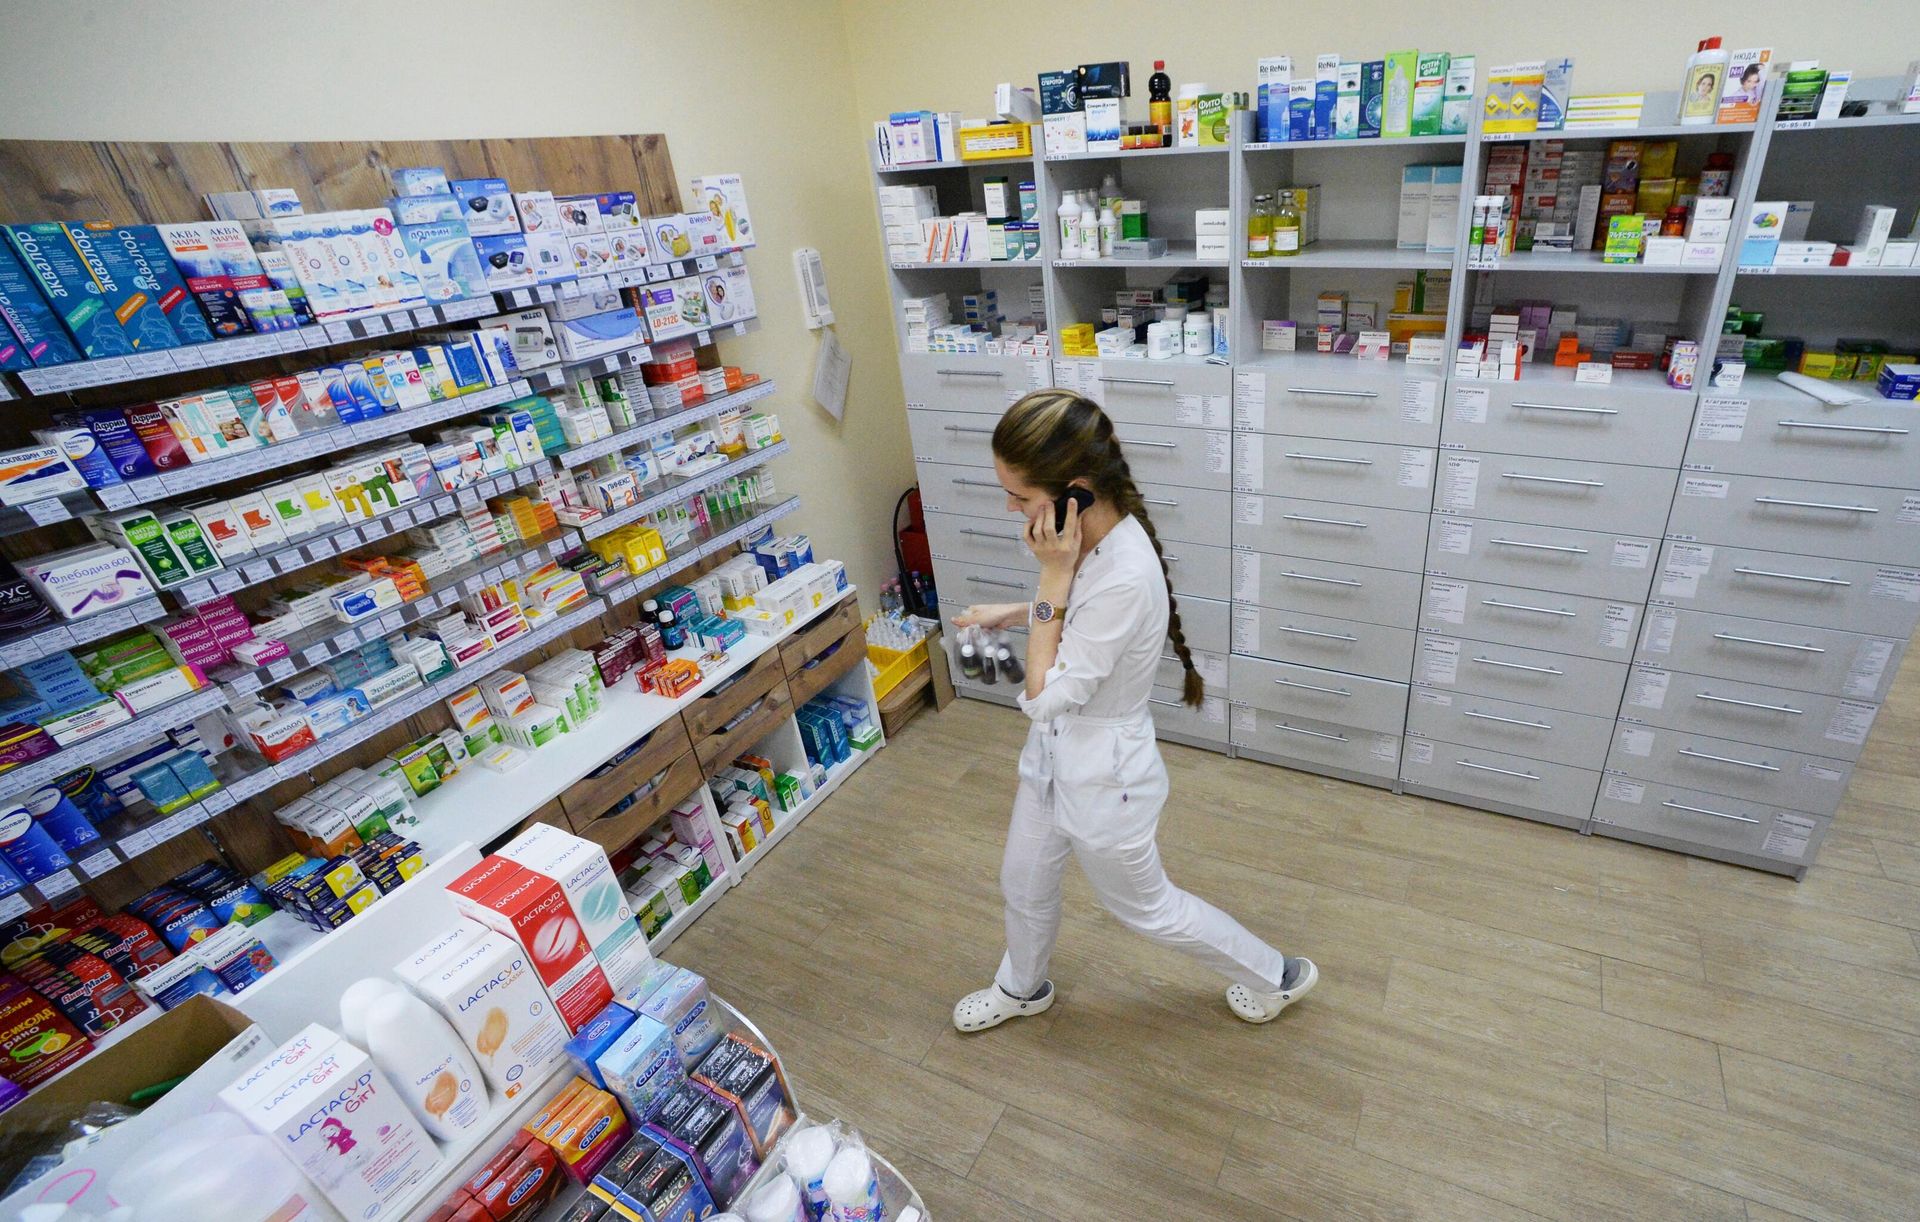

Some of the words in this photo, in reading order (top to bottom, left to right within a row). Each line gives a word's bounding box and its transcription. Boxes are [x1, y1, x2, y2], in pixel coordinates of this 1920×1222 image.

[1318, 62, 1336, 70] ReNu
[1734, 52, 1757, 60] НЮДА
[170, 230, 200, 239] АКВА
[210, 227, 239, 236] АКВА
[16, 232, 68, 297] аквалор
[71, 229, 118, 292] аквалор
[119, 230, 161, 291] аквалор
[95, 420, 126, 431] Африн
[132, 413, 162, 424] Африн
[607, 477, 630, 491] ЛИНЕКС
[50, 563, 111, 585] Флебодиа
[112, 555, 131, 568] 600
[597, 559, 622, 577] ТРИМЕДАТ
[165, 617, 200, 633] ИМУДОН
[203, 606, 235, 620] ИМУДОН
[213, 616, 245, 631] ИМУДОН
[176, 628, 209, 644] ИМУДОН
[219, 628, 250, 644] ИМУДОН
[182, 640, 216, 657] ИМУДОН
[255, 645, 286, 661] ИМУДОН
[370, 671, 416, 696] Эргоферон
[352, 802, 373, 820] Гербион
[323, 818, 345, 837] Гербион
[461, 860, 507, 892] LACTACYD
[566, 855, 605, 889] LACTACYD
[210, 883, 248, 907] COLDREX
[495, 876, 540, 909] LACTACYD
[166, 907, 205, 932] COLDREX
[518, 891, 561, 927] LACTACYD
[550, 901, 565, 915] EXTRA
[214, 936, 255, 966] Антигриппин
[153, 962, 199, 991] Антигриппин
[234, 982, 245, 991] 10
[459, 960, 522, 1011] LACTACYD
[501, 969, 525, 989] CLASSIC
[675, 1001, 706, 1035] durex
[236, 1036, 308, 1091] LACTACYD
[285, 1043, 312, 1066] Girl
[312, 1062, 340, 1085] Girl
[416, 1054, 452, 1086] LACTACYD
[636, 1050, 670, 1087] durex
[264, 1054, 336, 1111] LACTACYD
[288, 1069, 373, 1143] LACTACYD
[345, 1083, 376, 1113] Girl
[581, 1117, 610, 1150] durex
[509, 1169, 543, 1205] durex
[653, 1175, 688, 1217] SICO
